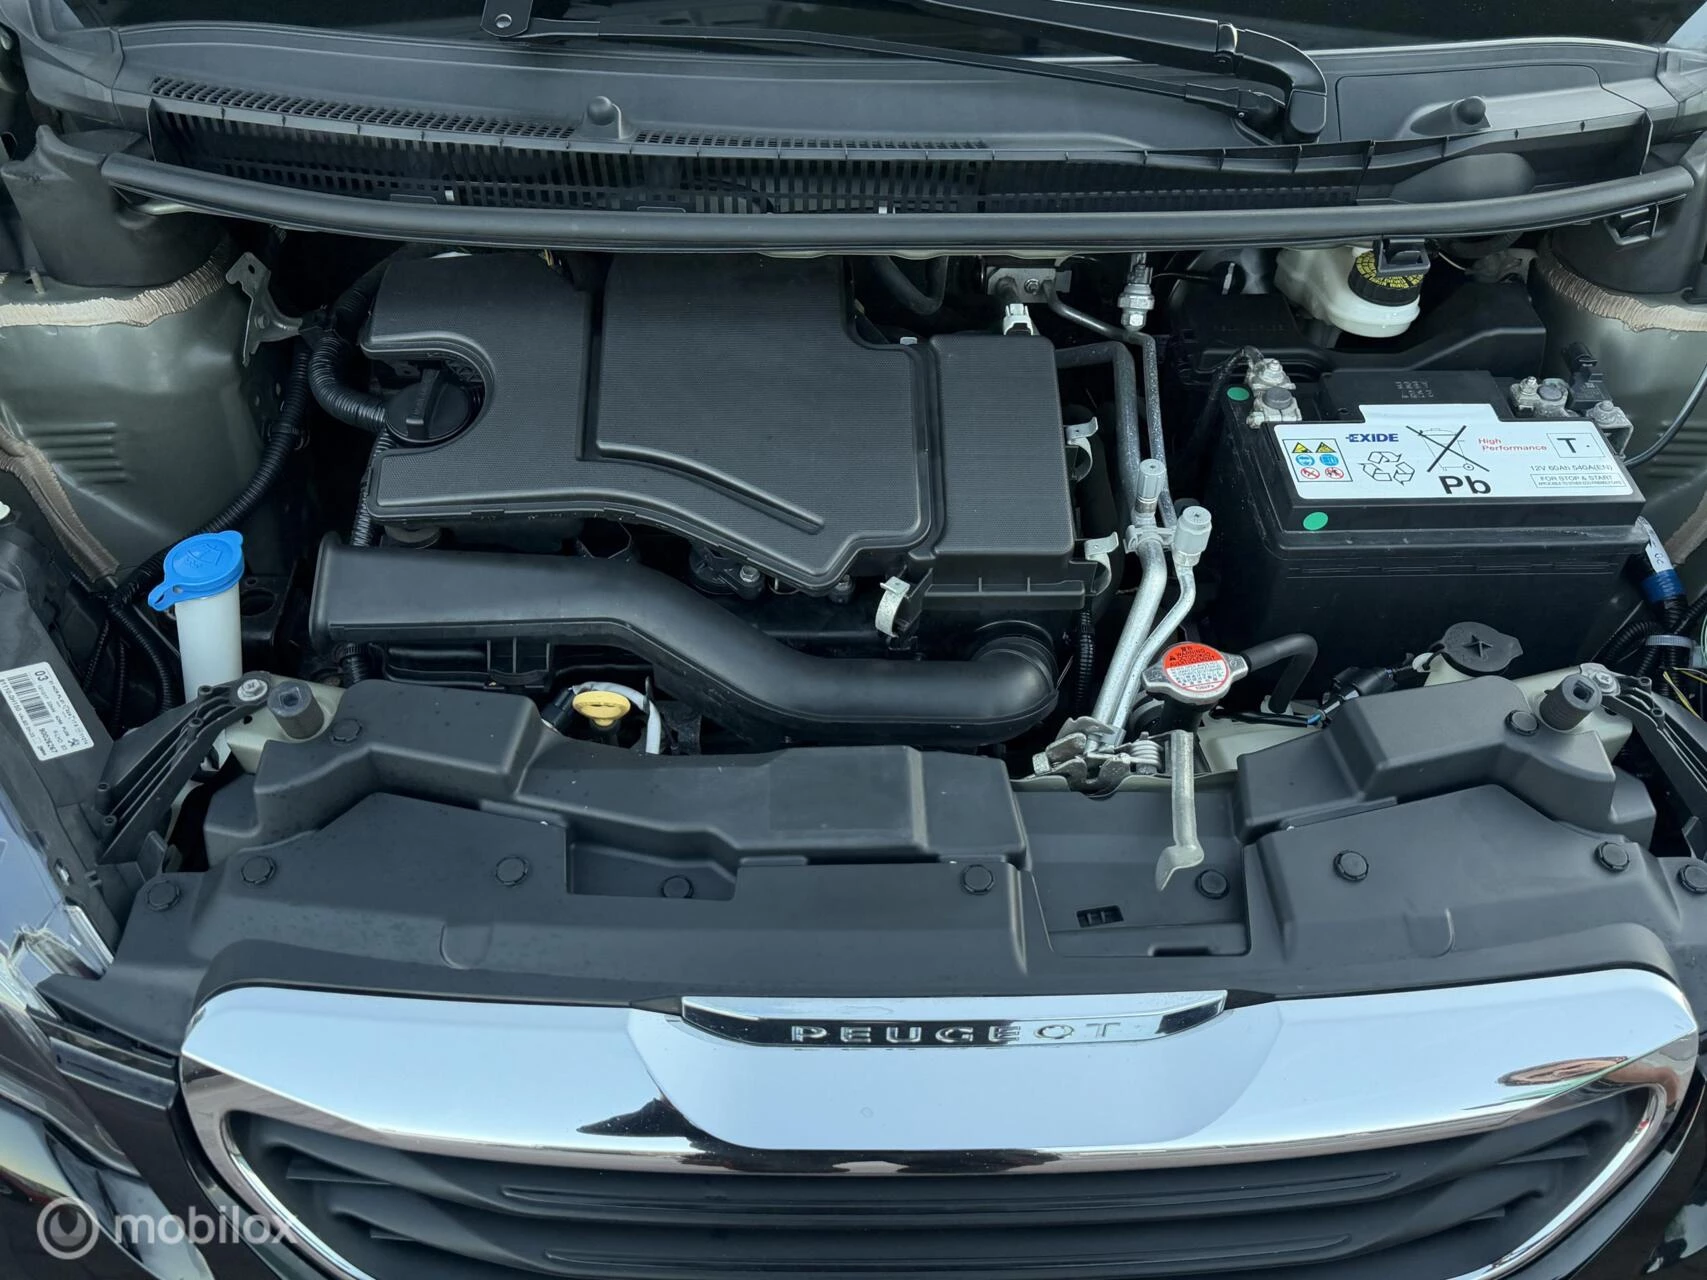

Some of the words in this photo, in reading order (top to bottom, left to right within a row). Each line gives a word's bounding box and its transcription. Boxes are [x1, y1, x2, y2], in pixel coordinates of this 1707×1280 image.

[1345, 433, 1399, 442] EXIDE
[1556, 438, 1577, 454] T
[1439, 475, 1491, 494] Pb
[34, 670, 49, 681] 03
[791, 1022, 1120, 1043] PEUGEOT
